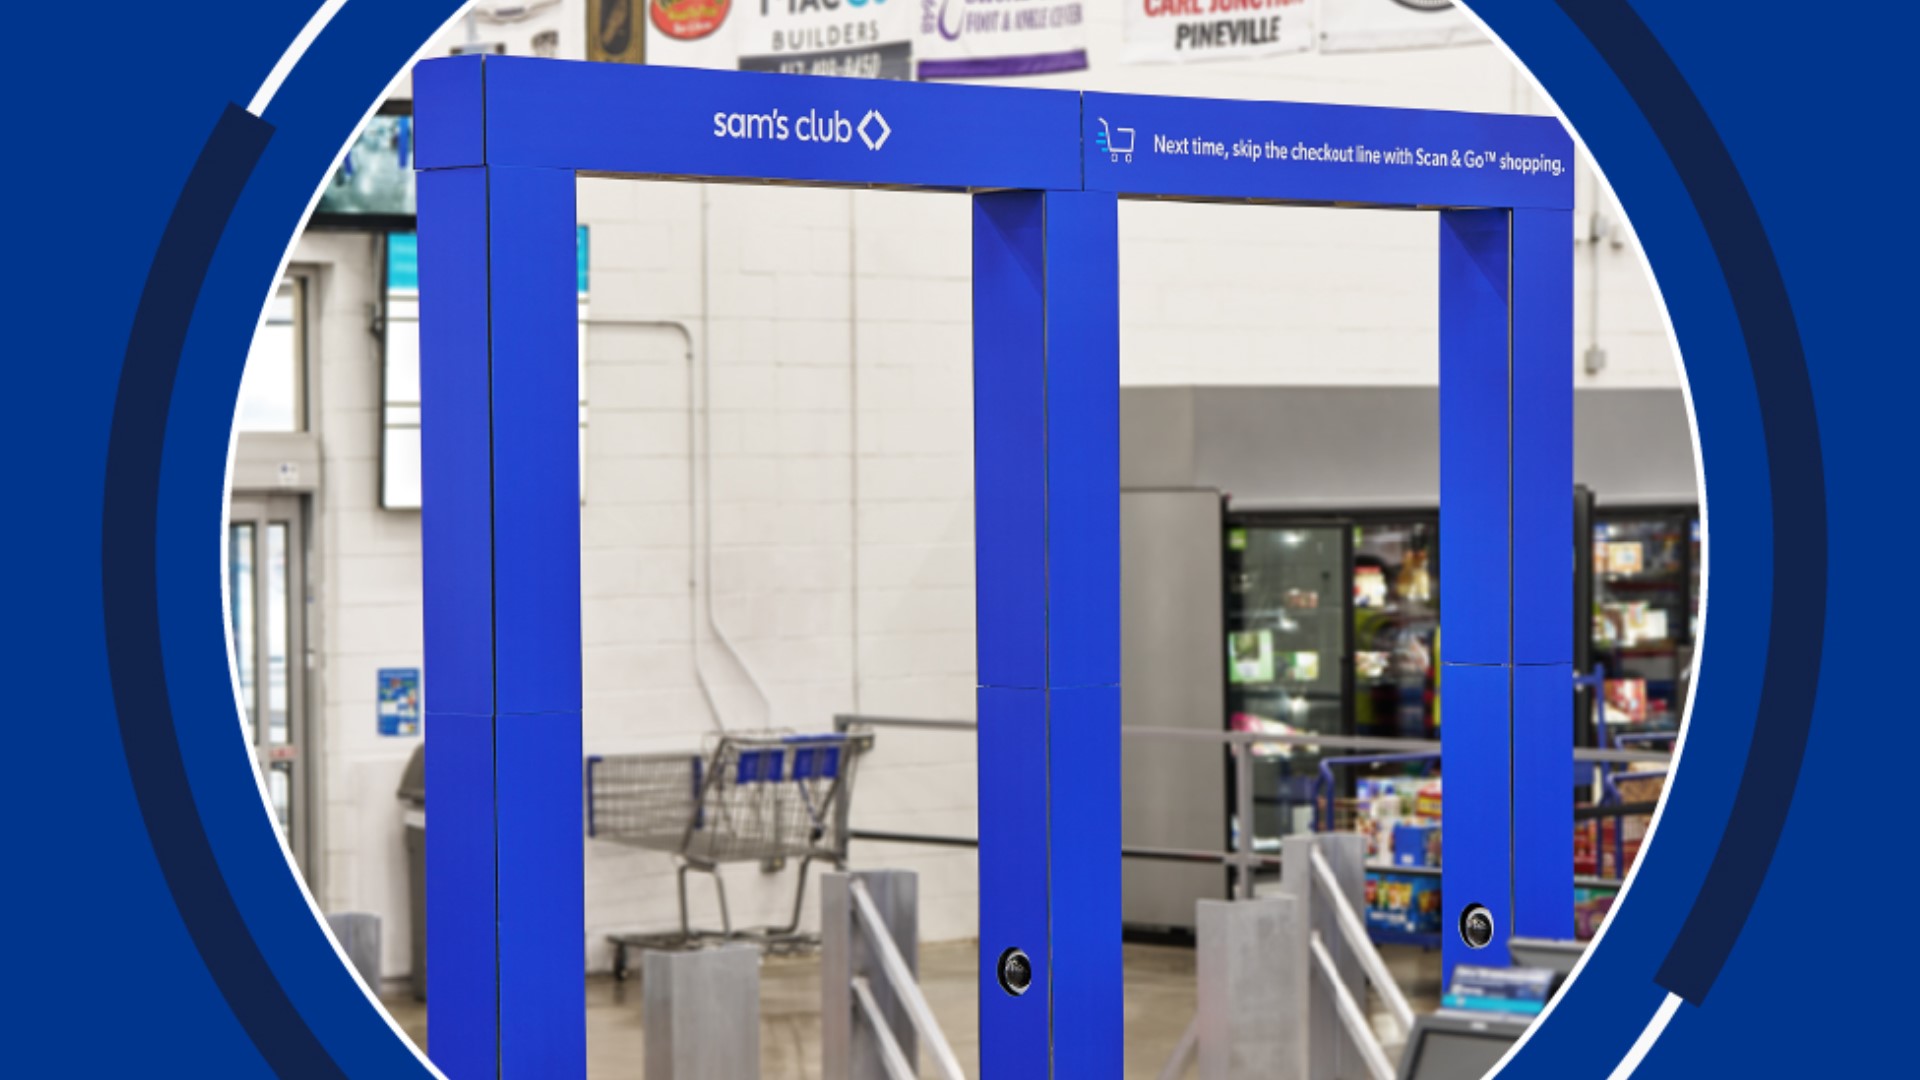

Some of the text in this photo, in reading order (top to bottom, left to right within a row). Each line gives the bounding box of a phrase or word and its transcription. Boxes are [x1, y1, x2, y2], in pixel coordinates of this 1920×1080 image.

[771, 20, 879, 51] BUILDERS
[1175, 16, 1281, 50] PINEVILLE
[713, 108, 853, 143] sam's club
[1154, 133, 1189, 155] Next
[1192, 136, 1230, 160] time,
[1232, 138, 1262, 163] skip
[1265, 140, 1288, 160] the
[1291, 141, 1354, 163] checkout
[1355, 144, 1381, 165] line
[1383, 146, 1414, 166] with
[1416, 147, 1449, 168] Scan
[1451, 149, 1462, 168] &
[1500, 152, 1566, 177] shopping.
